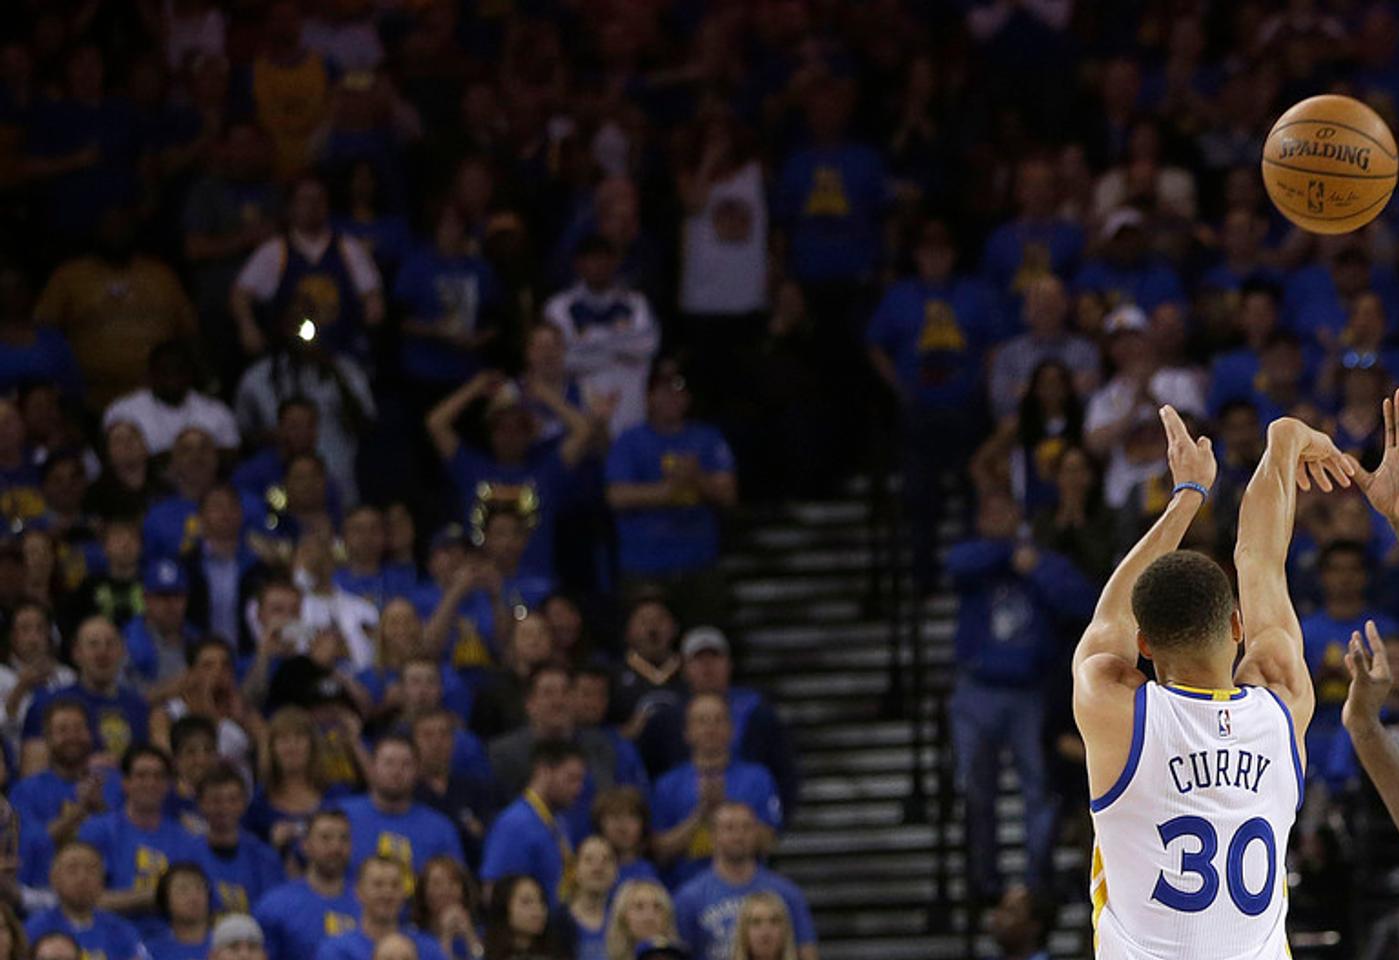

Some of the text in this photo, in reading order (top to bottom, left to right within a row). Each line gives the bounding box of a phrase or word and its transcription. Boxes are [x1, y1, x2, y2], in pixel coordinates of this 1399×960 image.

[1279, 139, 1370, 171] SPALDING
[1168, 748, 1271, 794] CURRY
[1151, 814, 1276, 917] 30
